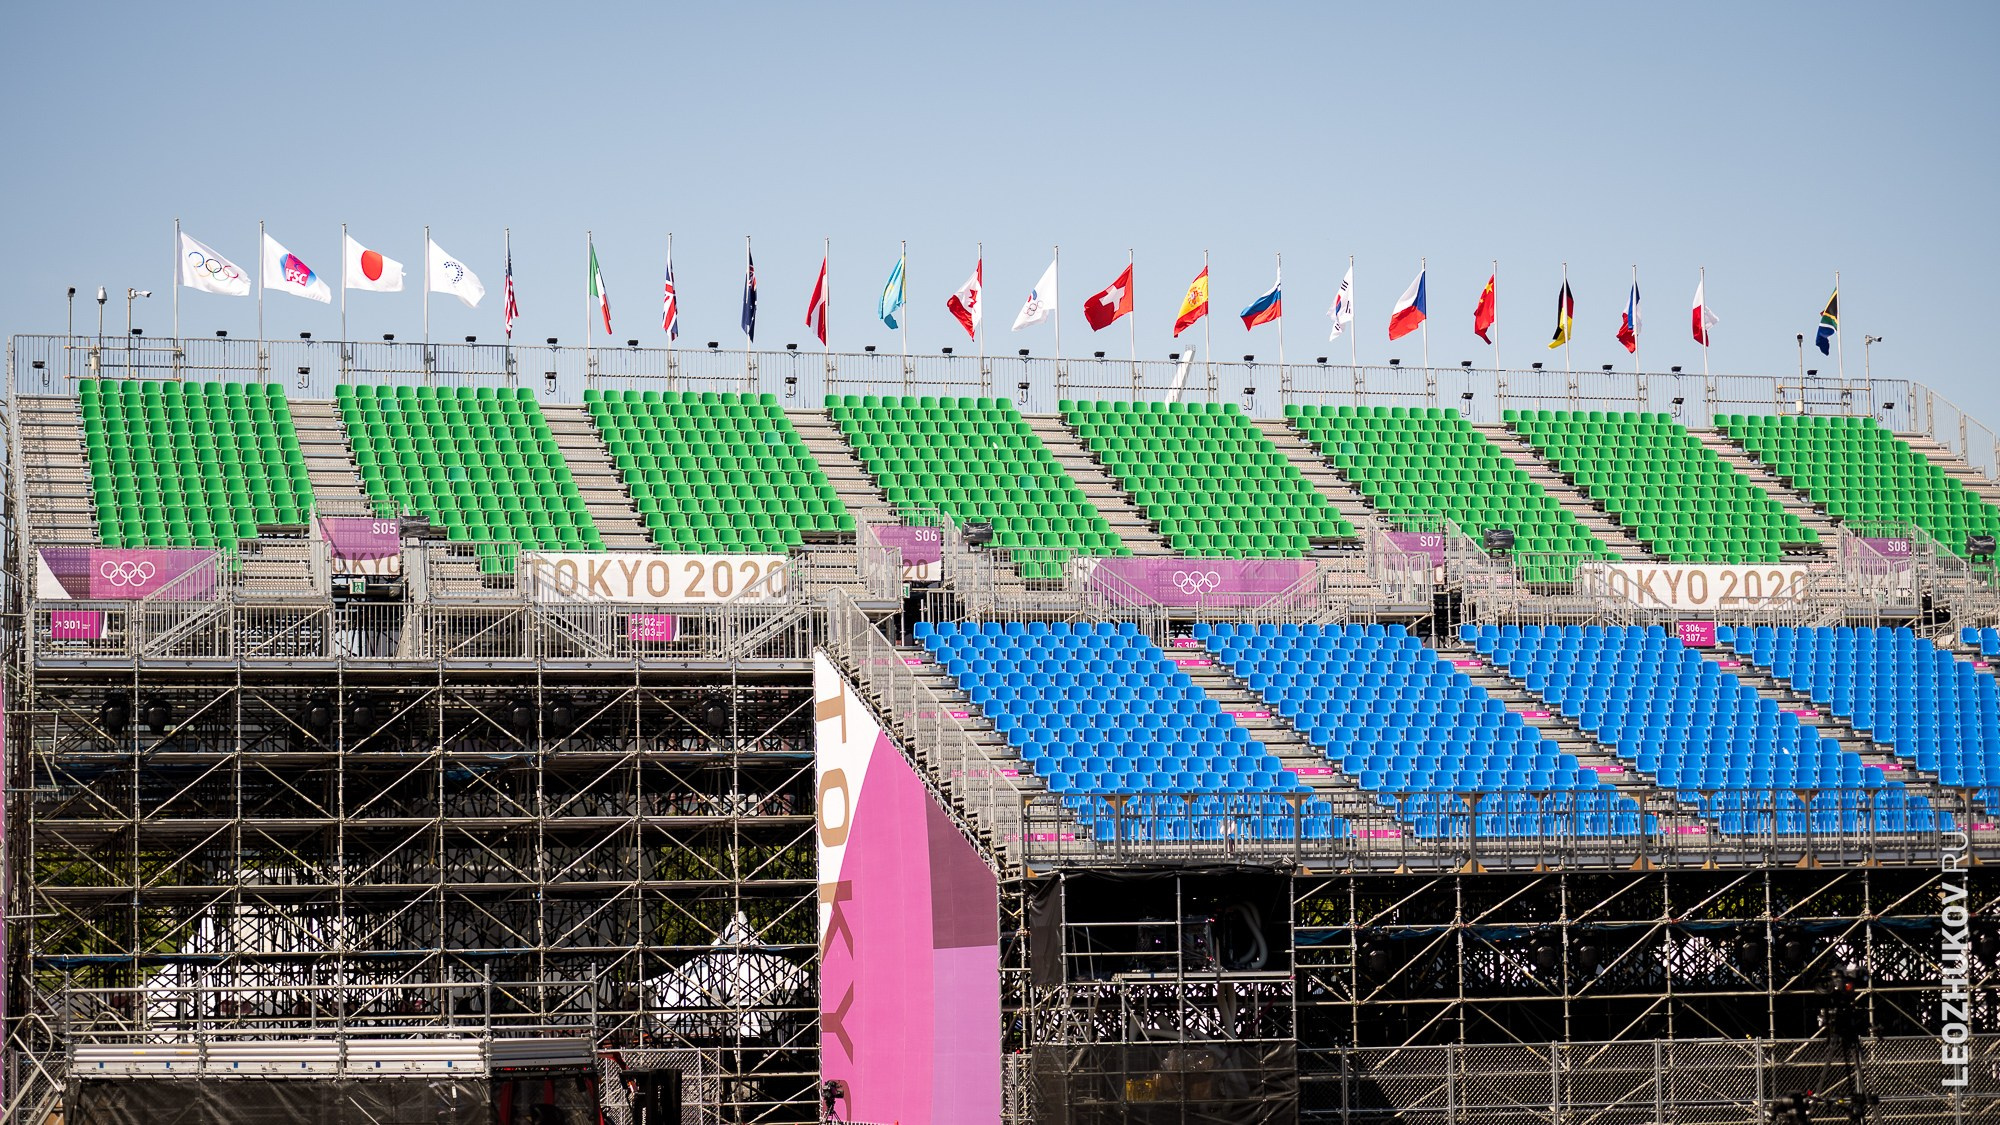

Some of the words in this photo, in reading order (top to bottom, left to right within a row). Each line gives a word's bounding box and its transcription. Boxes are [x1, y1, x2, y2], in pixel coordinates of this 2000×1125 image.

[372, 522, 397, 534] S05
[915, 530, 937, 541] S06
[1420, 536, 1441, 547] S07
[1887, 541, 1907, 552] S08
[684, 560, 788, 598] 2020
[1719, 570, 1809, 605] 2020
[63, 620, 81, 630] 301
[1685, 624, 1700, 632] 306
[1685, 633, 1700, 642] 307
